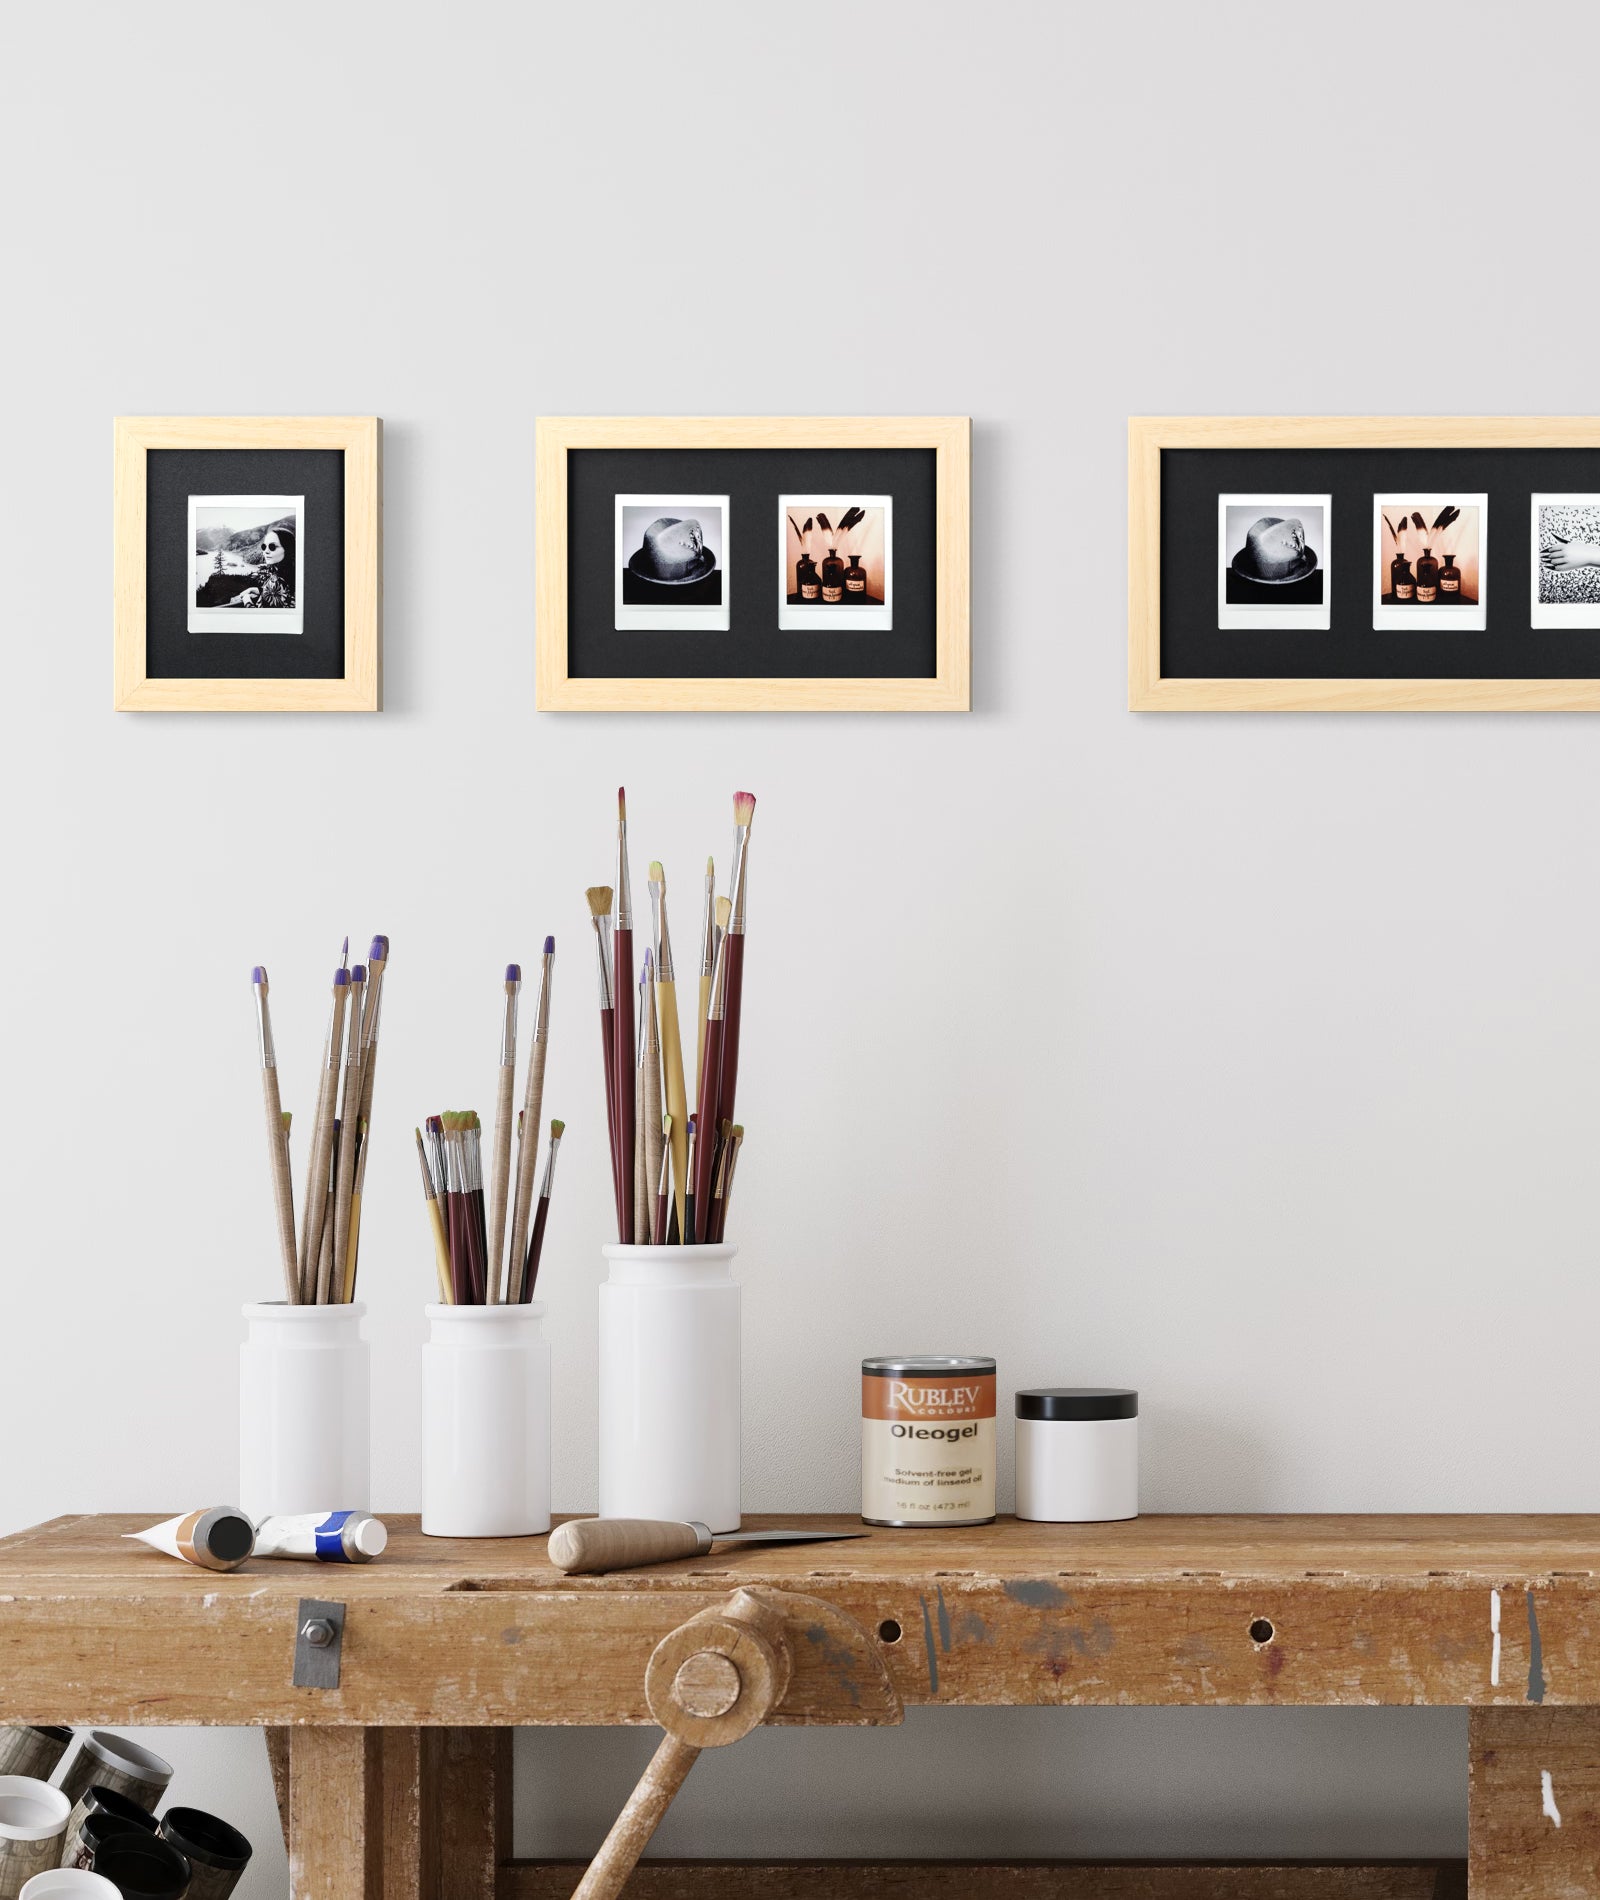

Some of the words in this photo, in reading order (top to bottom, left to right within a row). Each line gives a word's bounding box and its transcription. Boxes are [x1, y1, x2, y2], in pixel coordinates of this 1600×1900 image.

[887, 1380, 980, 1415] RUBLEV
[891, 1423, 978, 1442] Oleogel
[895, 1468, 957, 1478] Solvent-free
[959, 1467, 973, 1477] gel
[884, 1476, 920, 1486] medium
[937, 1478, 971, 1486] linseed
[972, 1474, 982, 1483] oil
[918, 1503, 931, 1511] oz
